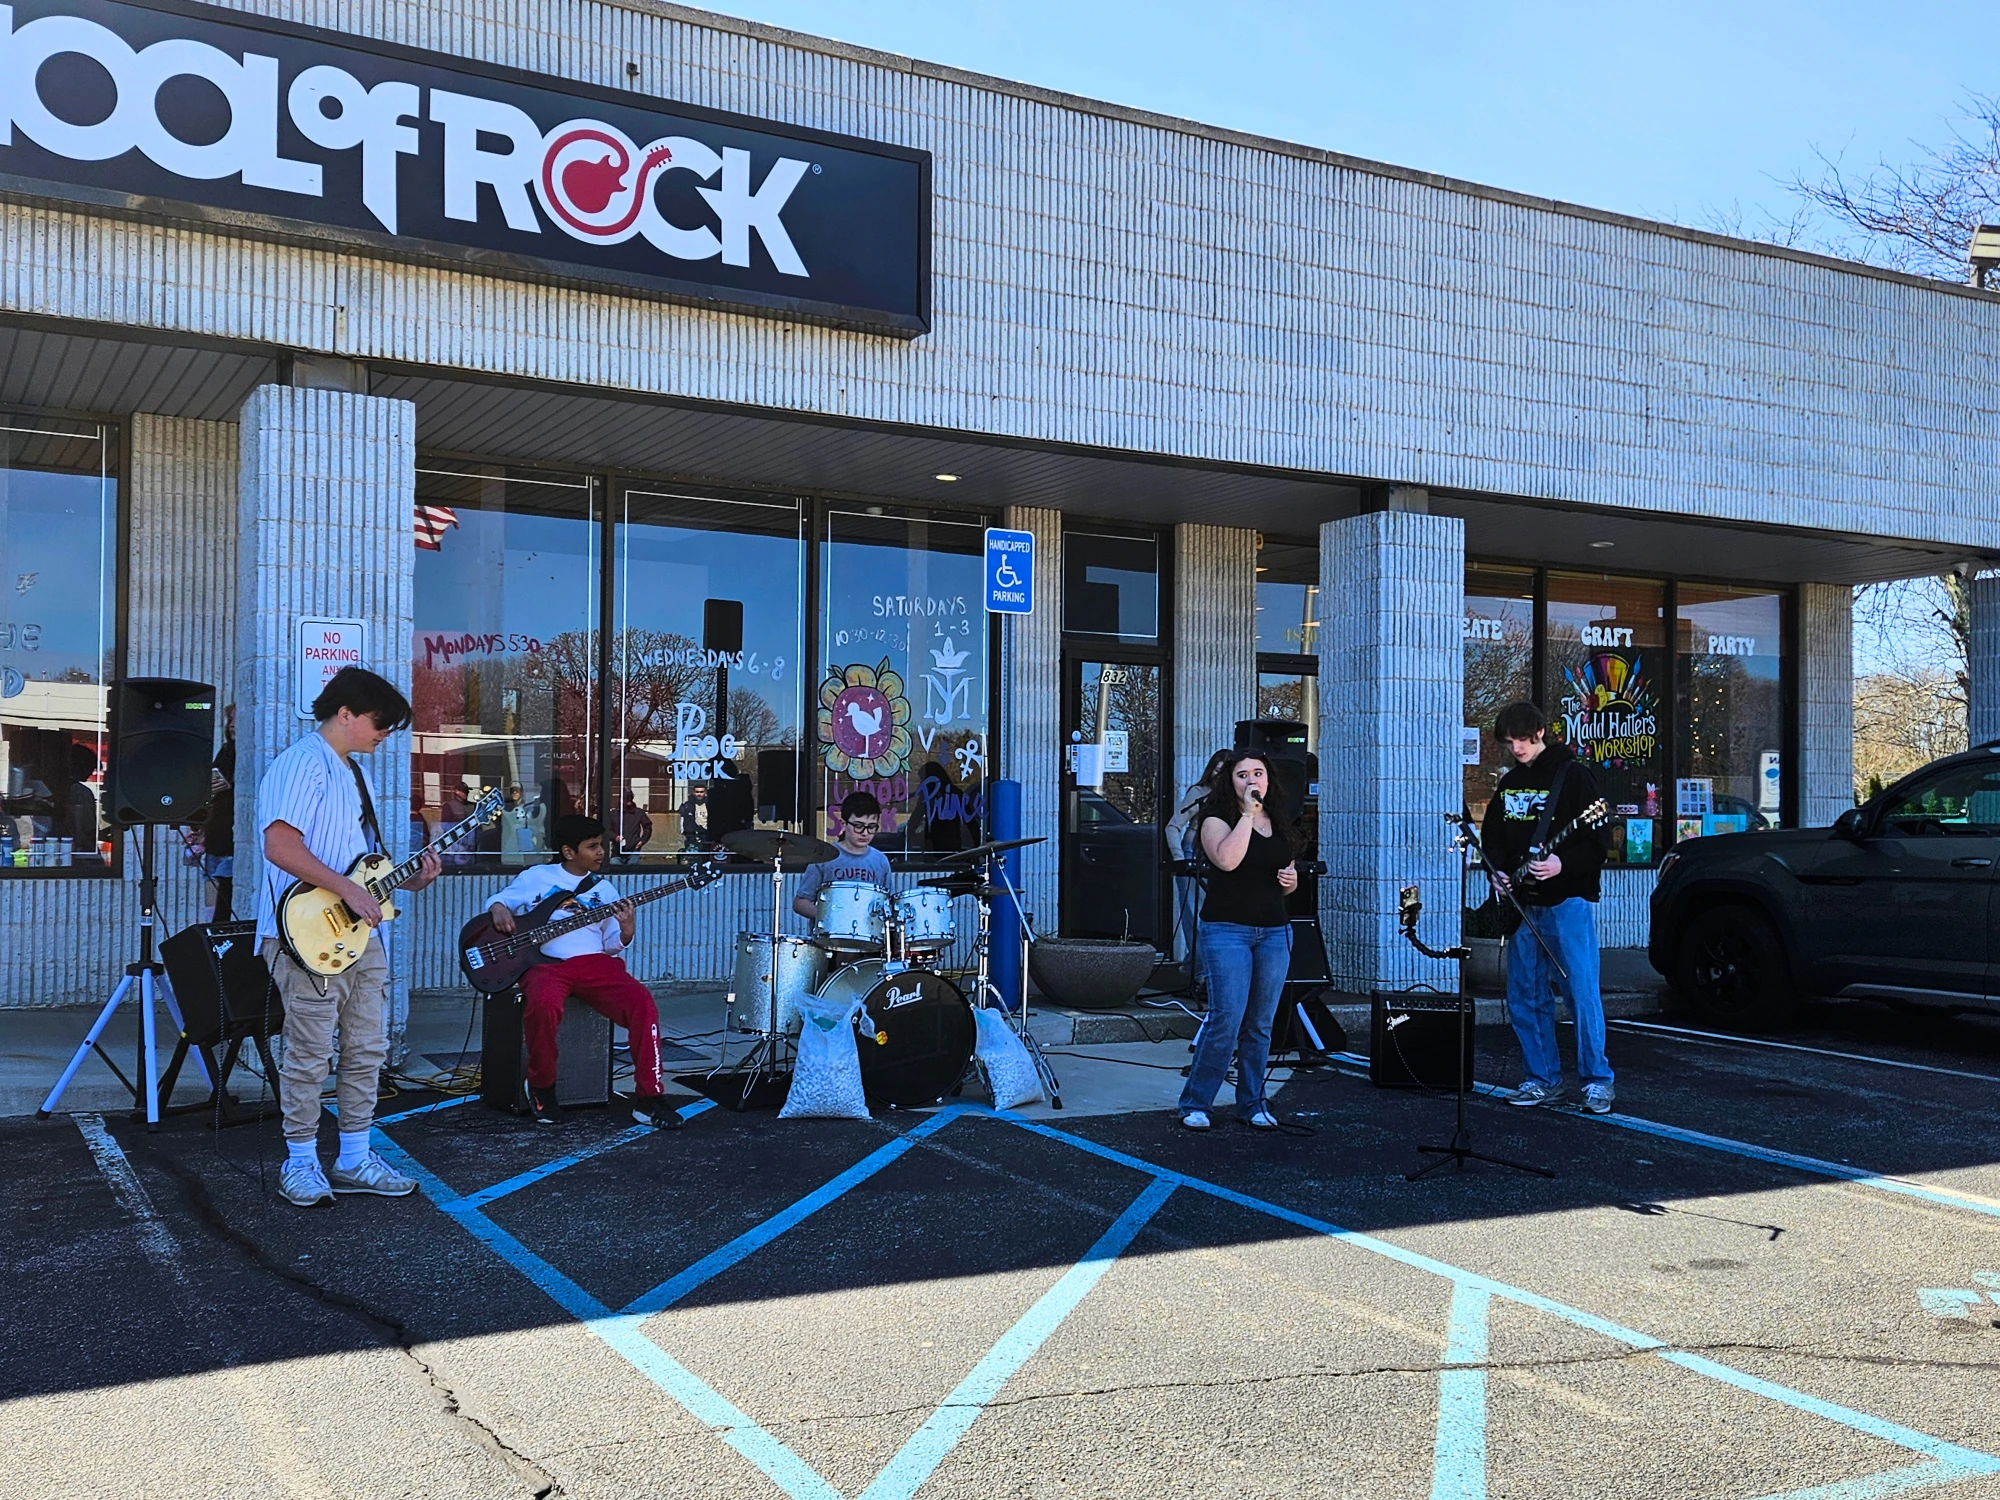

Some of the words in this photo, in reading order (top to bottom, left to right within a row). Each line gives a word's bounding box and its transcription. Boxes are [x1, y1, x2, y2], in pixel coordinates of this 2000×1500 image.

[430, 88, 811, 278] ROCK
[989, 539, 1031, 553] HANDICAPPED
[873, 595, 967, 618] SATURDAYS
[993, 590, 1025, 603] PARKING
[323, 632, 341, 644] NO
[1581, 626, 1634, 647] CRAFT
[1708, 635, 1755, 656] PARTY
[305, 648, 359, 661] PARKING
[424, 633, 505, 669] MONDAYS
[638, 648, 744, 671] WEDNESDAYS
[1102, 671, 1127, 683] 832
[1561, 695, 1581, 716] The
[1561, 712, 1605, 748] Madd
[1607, 710, 1656, 740] Hatter's
[1590, 735, 1655, 763] WORKSHOP
[672, 759, 736, 780] ROCK
[915, 776, 990, 833] Prince
[834, 867, 876, 881] QUEEN
[883, 982, 923, 1010] Pearl
